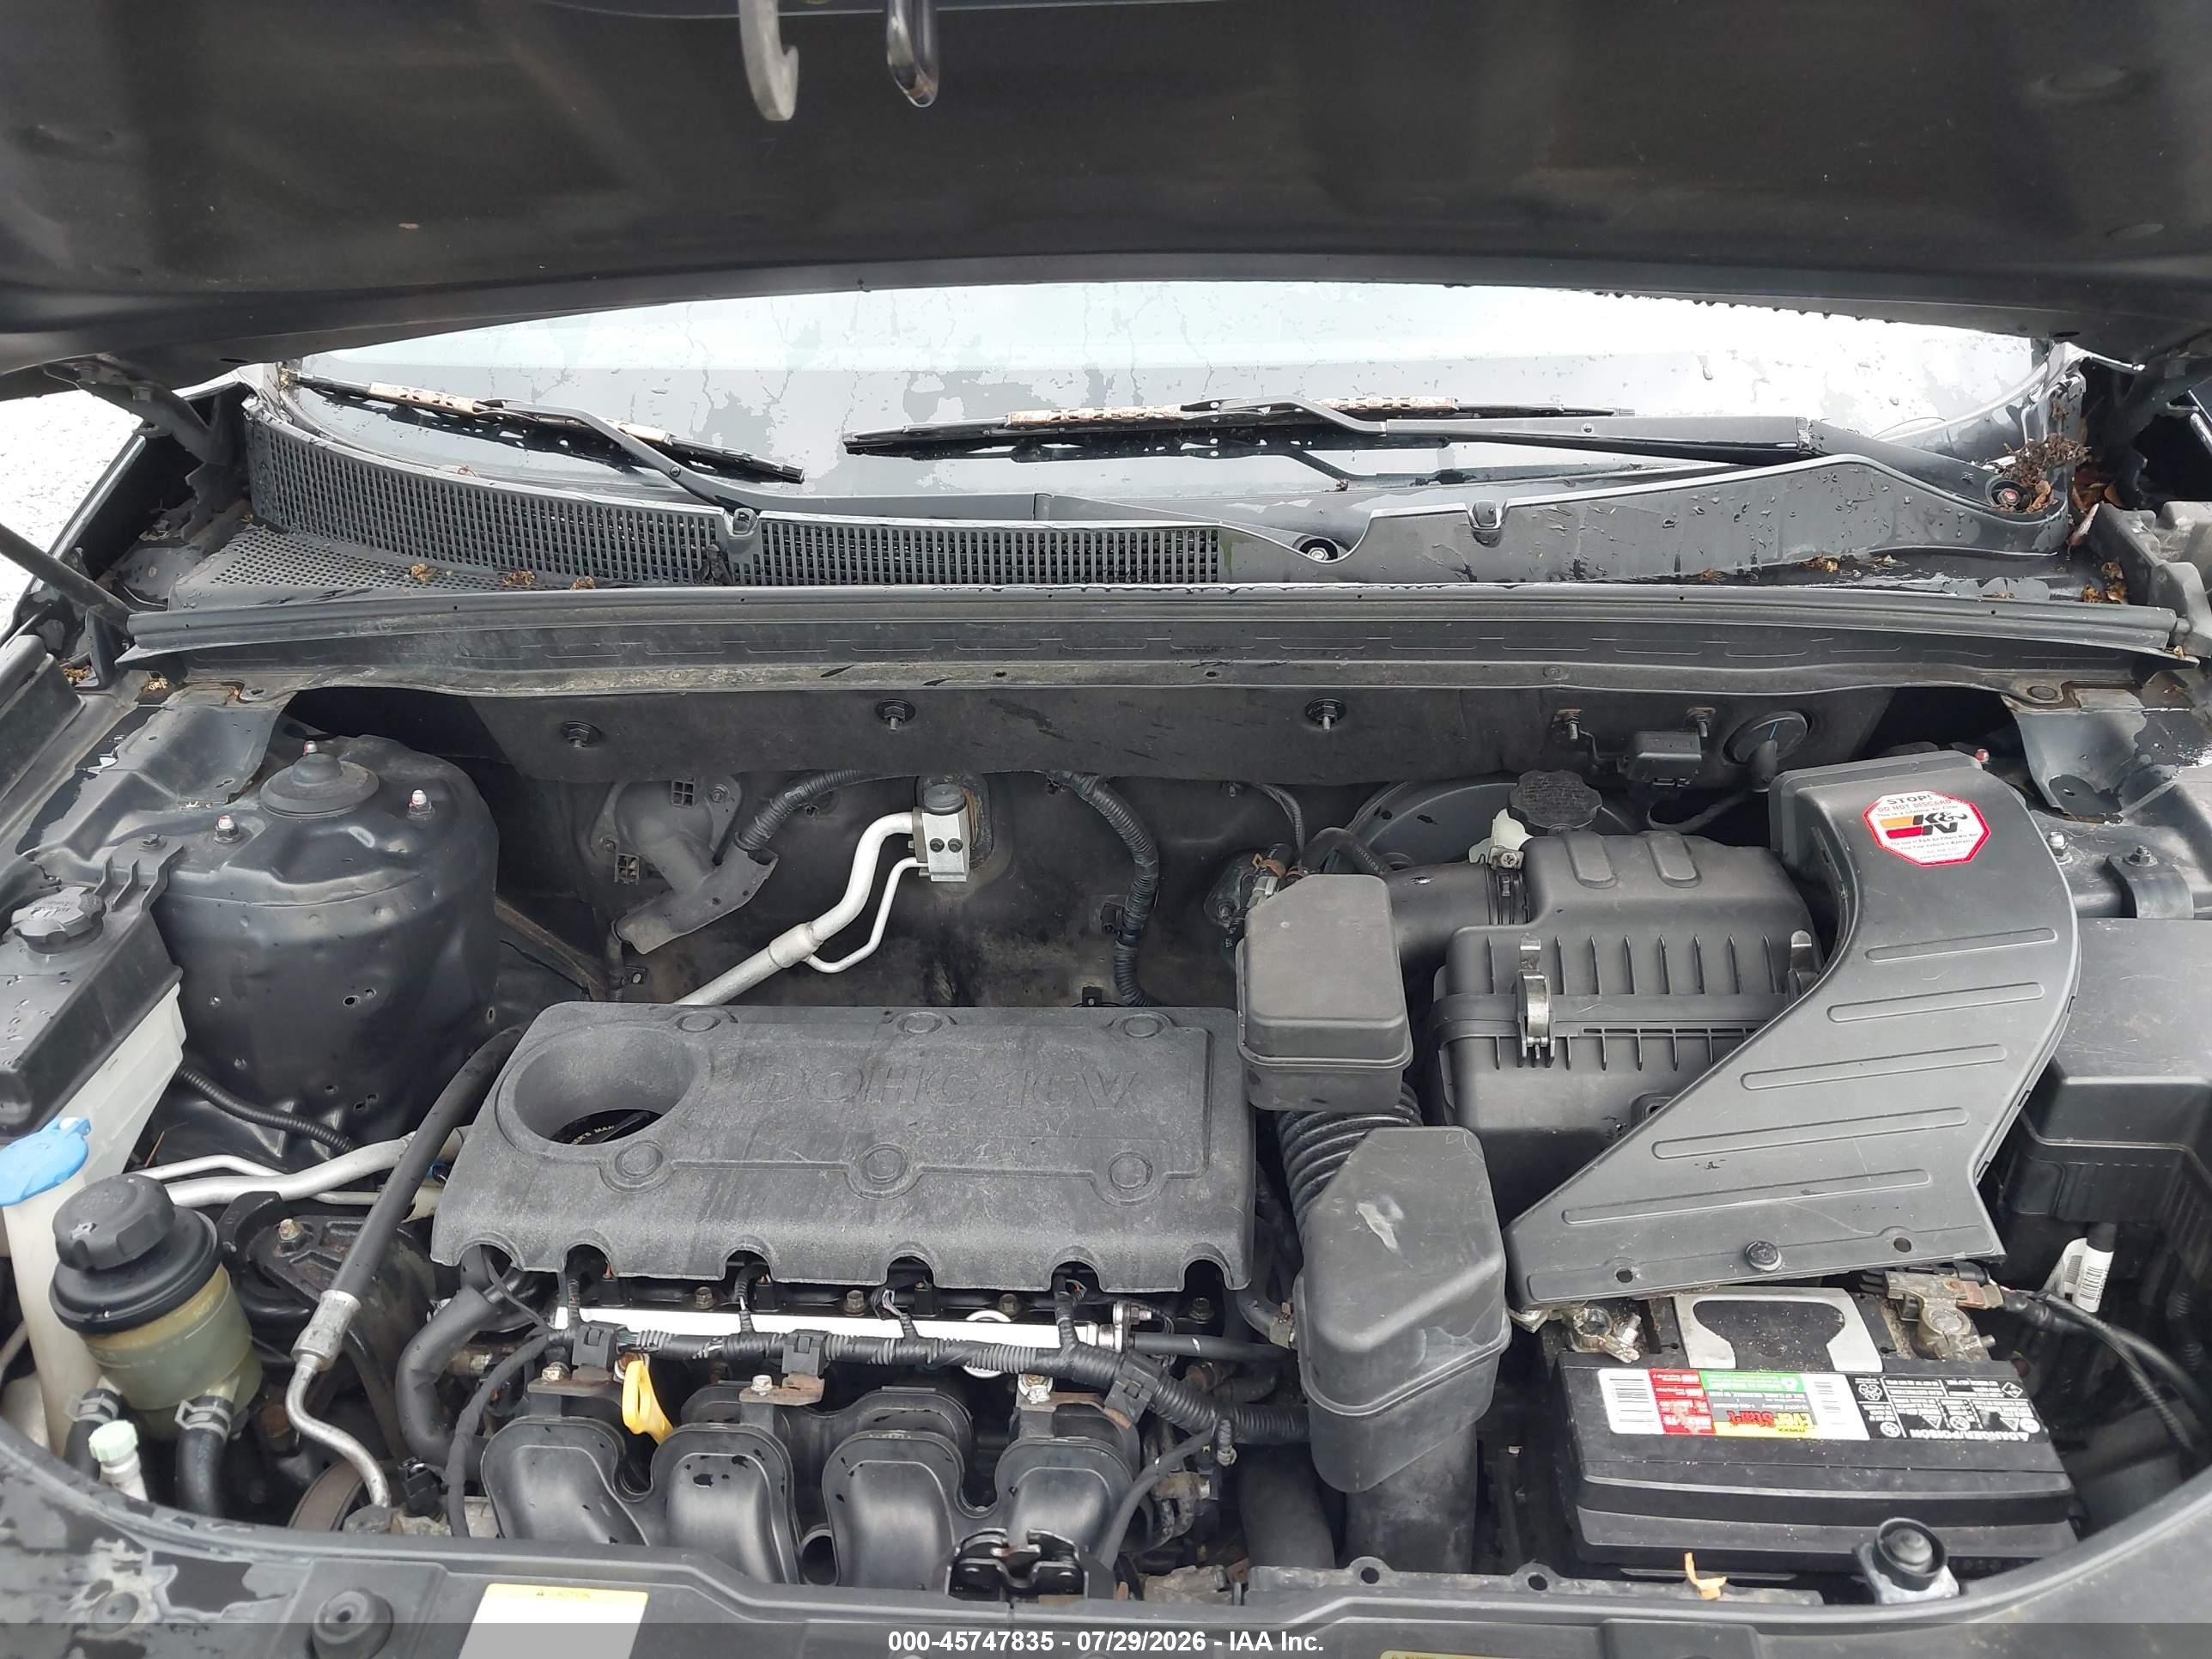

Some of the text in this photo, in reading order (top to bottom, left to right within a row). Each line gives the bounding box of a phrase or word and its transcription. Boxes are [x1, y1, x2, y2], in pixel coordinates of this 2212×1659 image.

[1877, 799, 1953, 812] DO NOT DISCARD
[1887, 794, 1932, 805] STOP!
[1912, 811, 1968, 836] K&N
